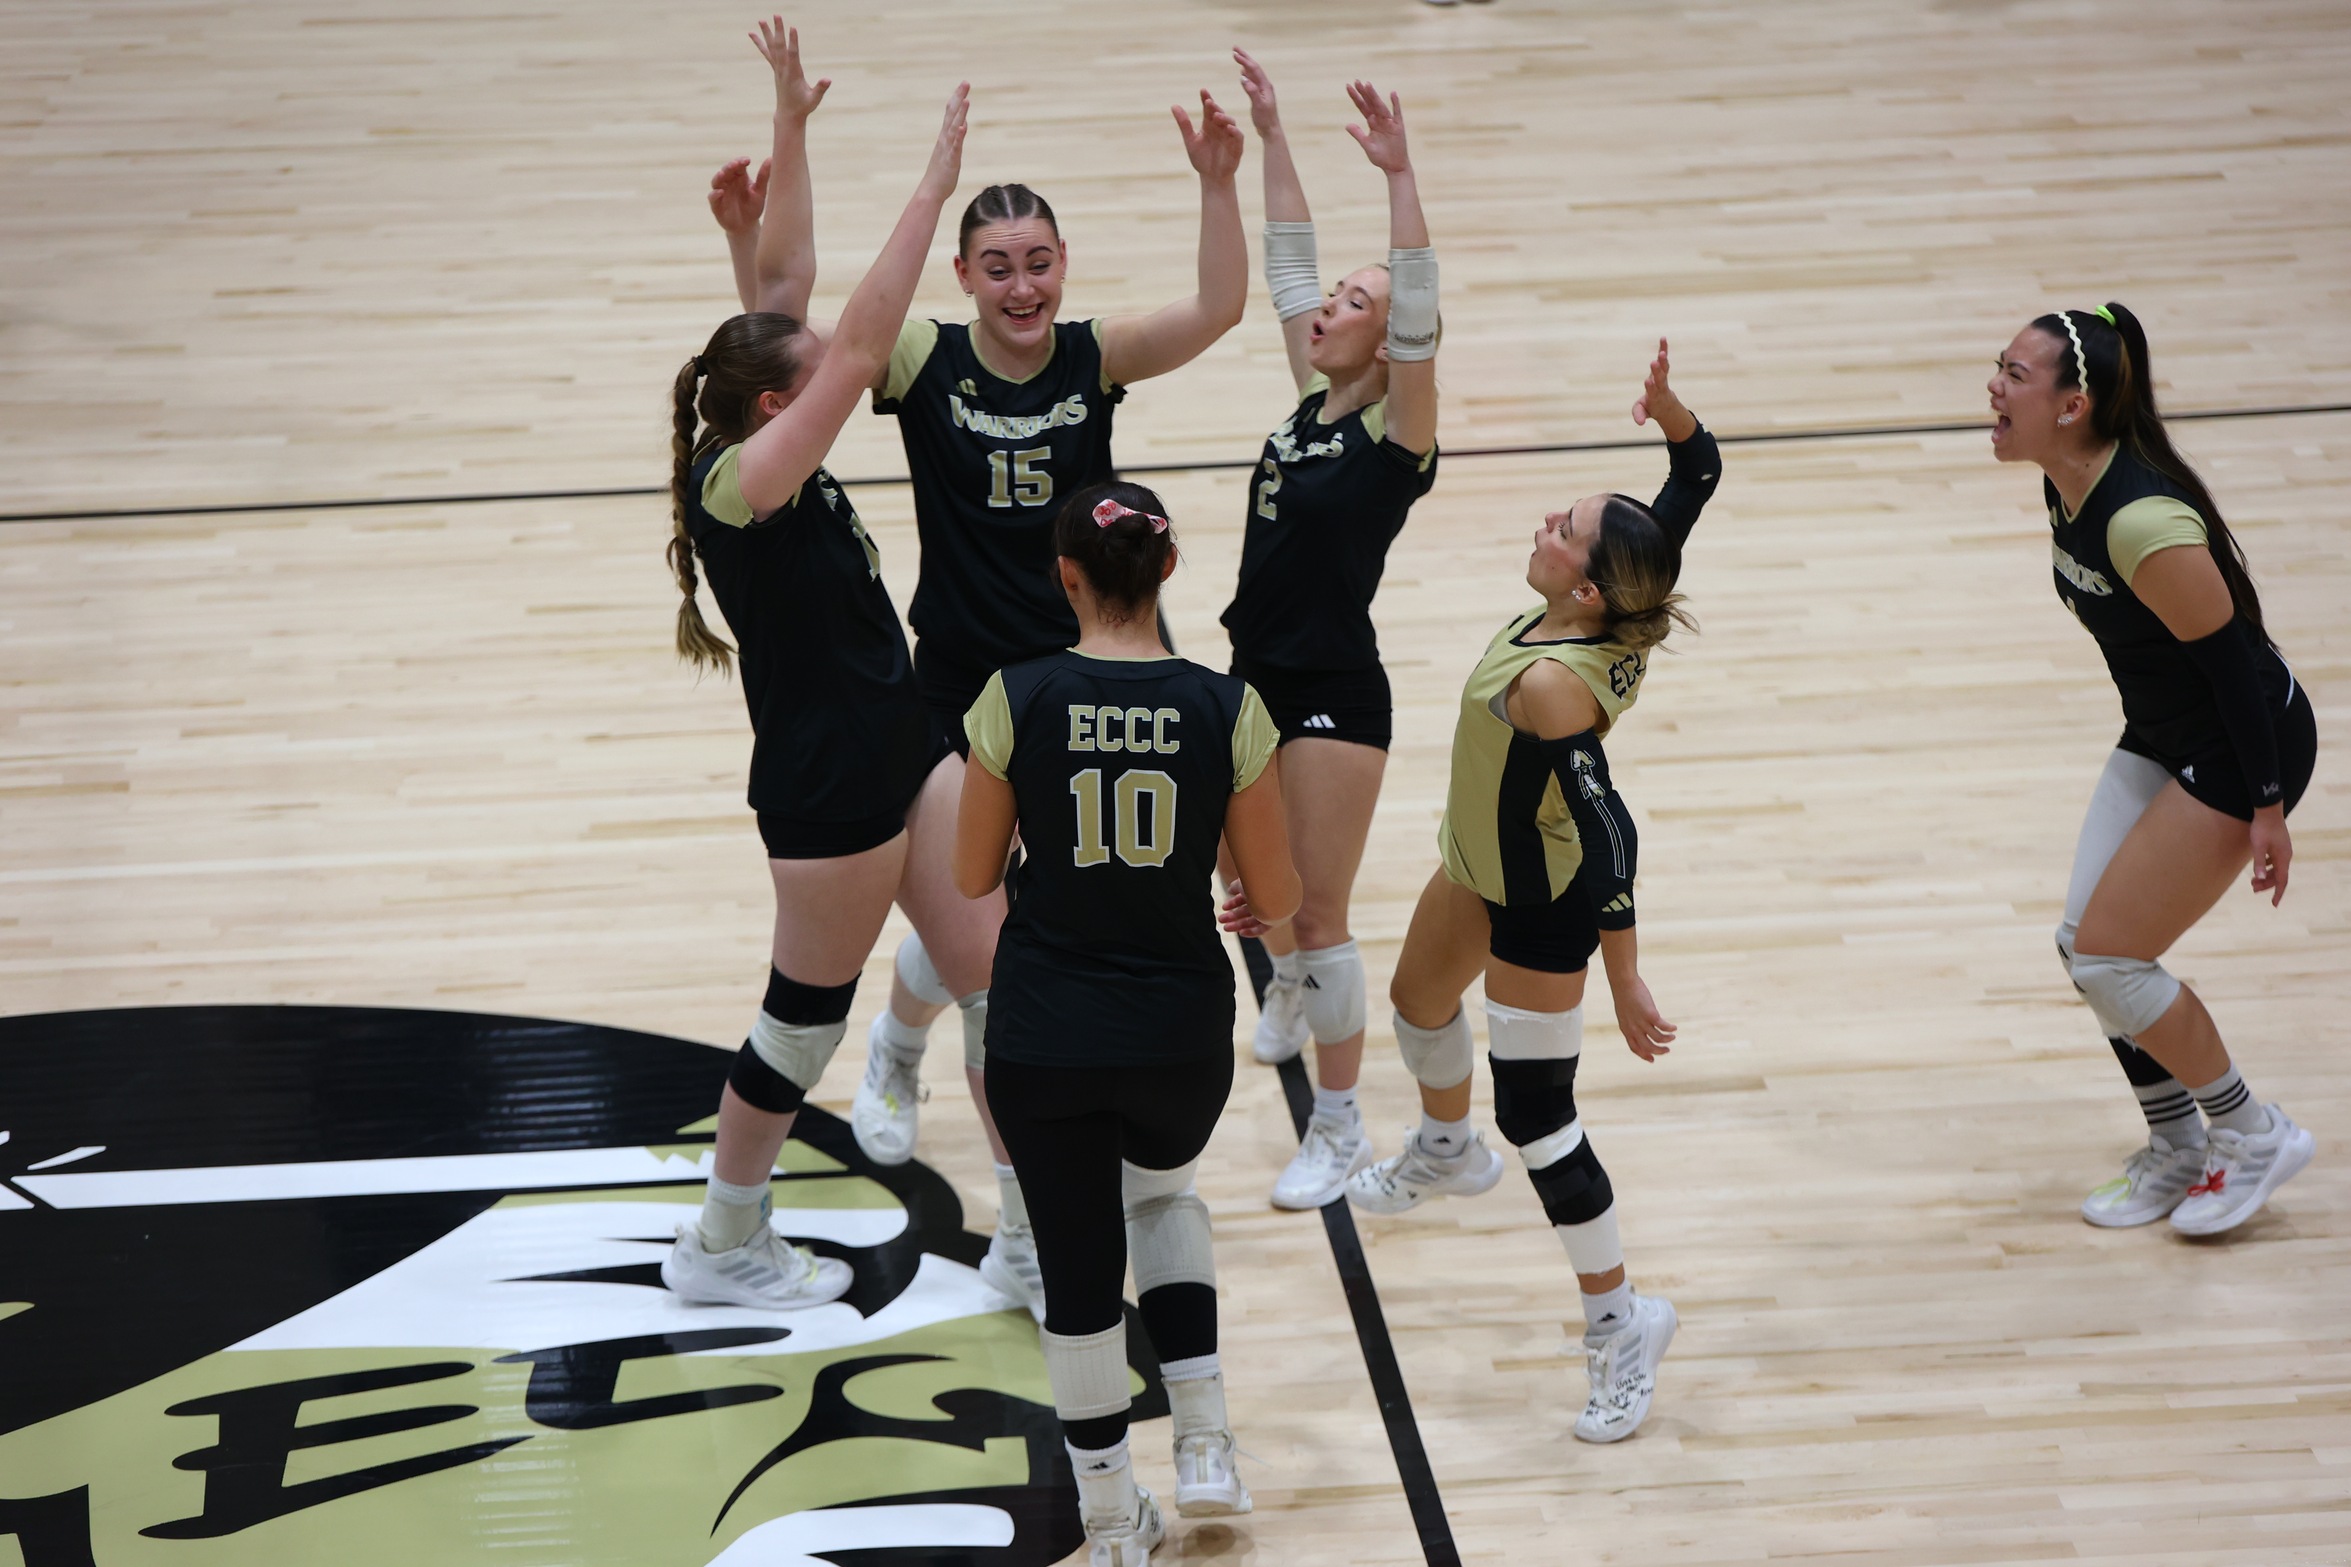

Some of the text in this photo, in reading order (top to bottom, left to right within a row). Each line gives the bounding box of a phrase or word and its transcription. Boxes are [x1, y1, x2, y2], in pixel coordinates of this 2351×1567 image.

[948, 394, 1088, 439] WARRIORS
[987, 446, 1053, 508] 15
[1257, 457, 1283, 521] 2
[1068, 705, 1180, 754] ECCC
[1070, 768, 1177, 867] 10
